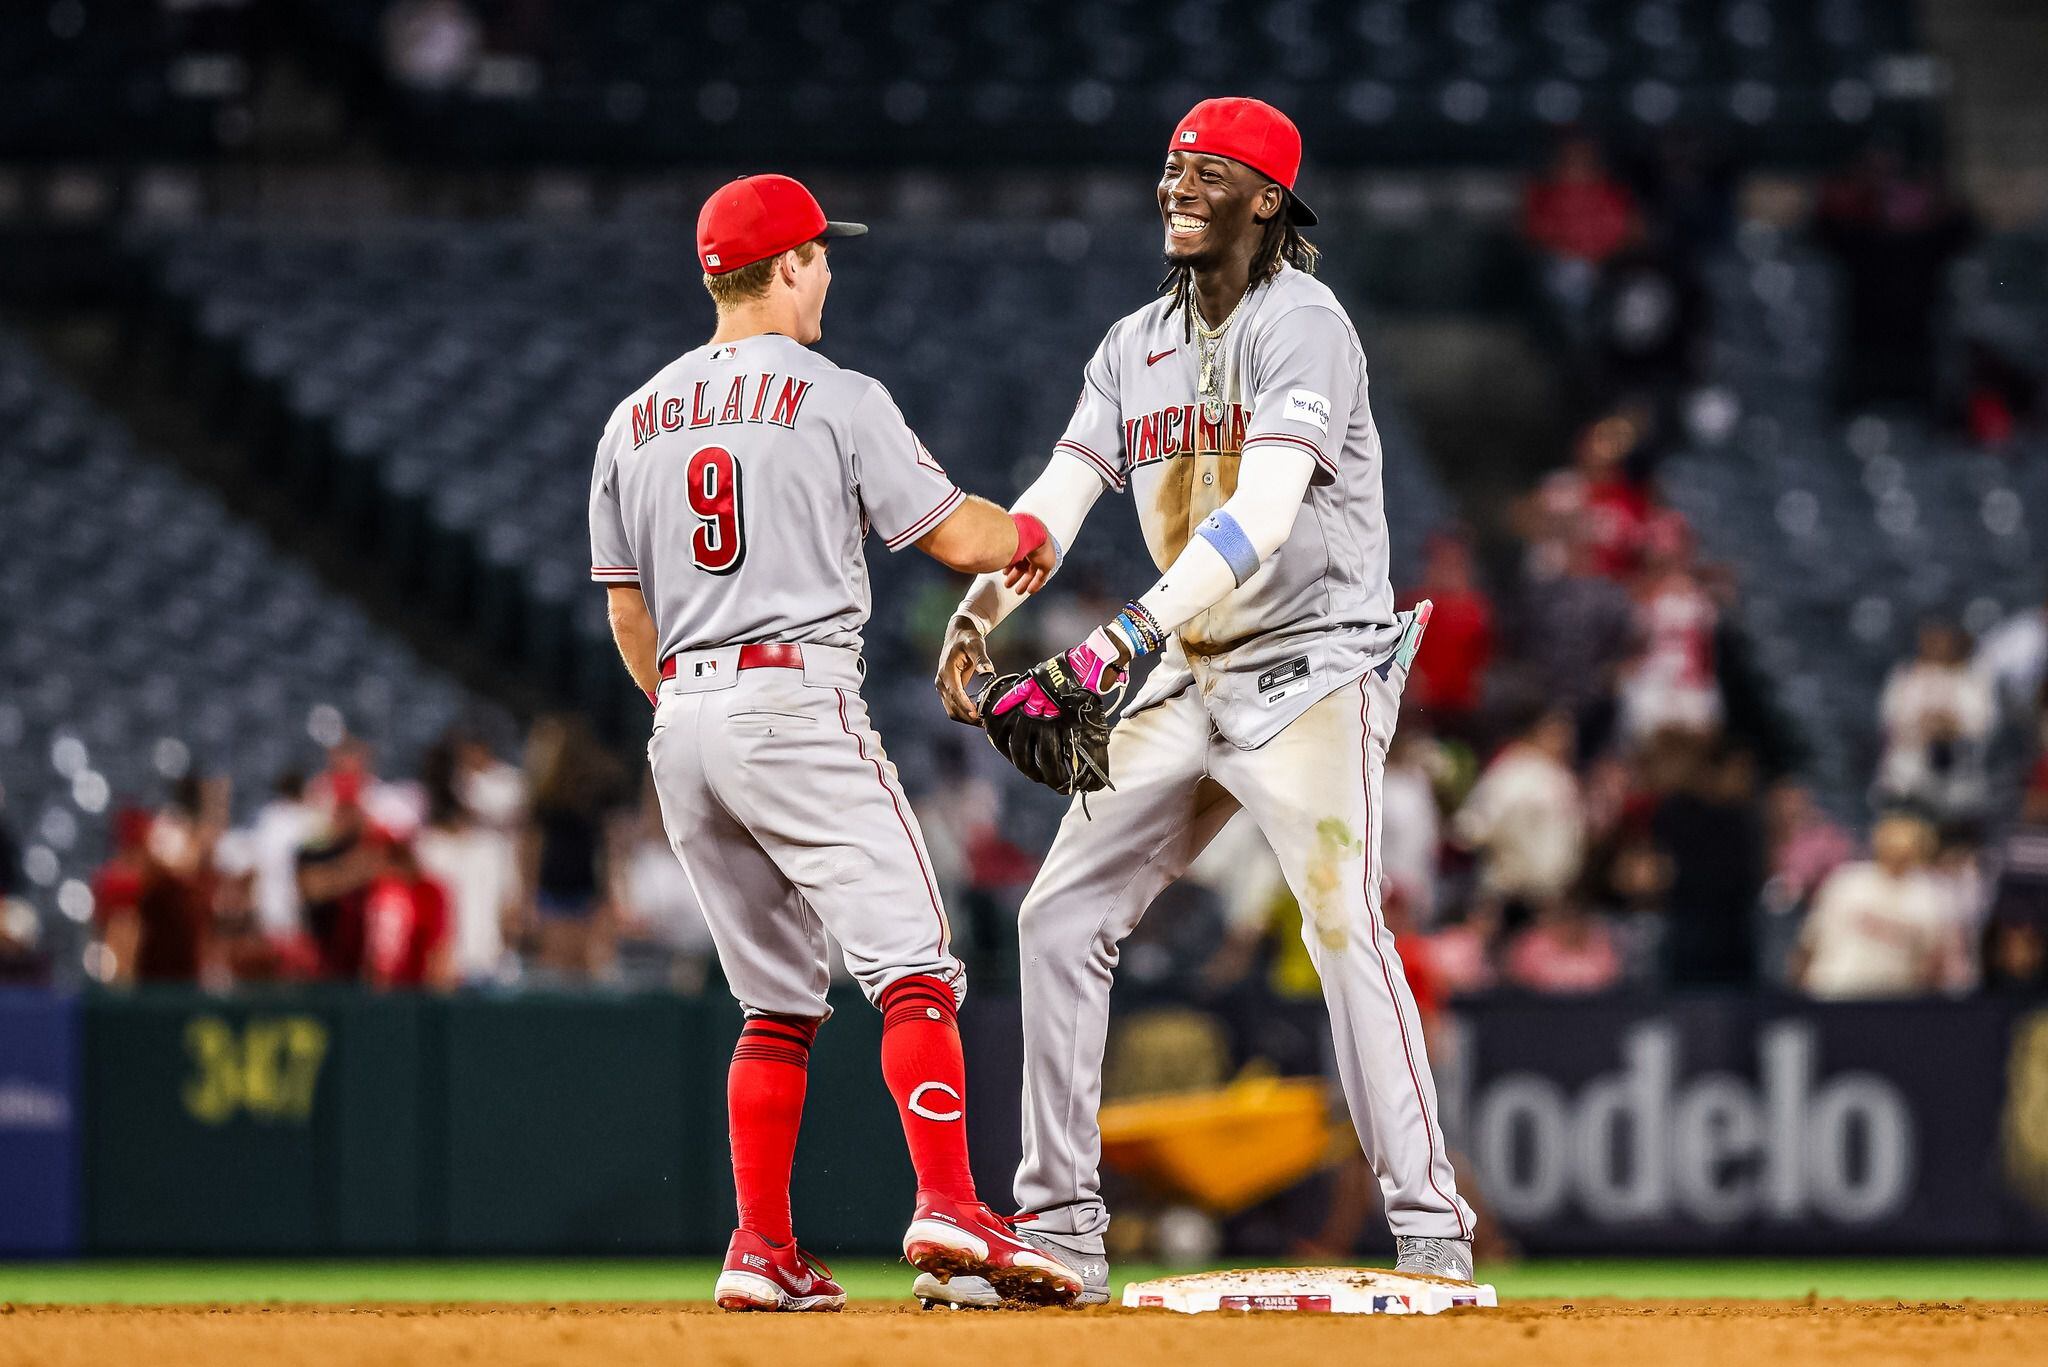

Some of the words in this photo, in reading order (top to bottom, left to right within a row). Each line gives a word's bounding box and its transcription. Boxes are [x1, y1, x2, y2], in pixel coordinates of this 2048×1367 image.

[631, 372, 813, 450] McLAIN
[684, 443, 746, 576] 9
[908, 1081, 962, 1122] C
[1438, 1015, 1914, 1224] odelo
